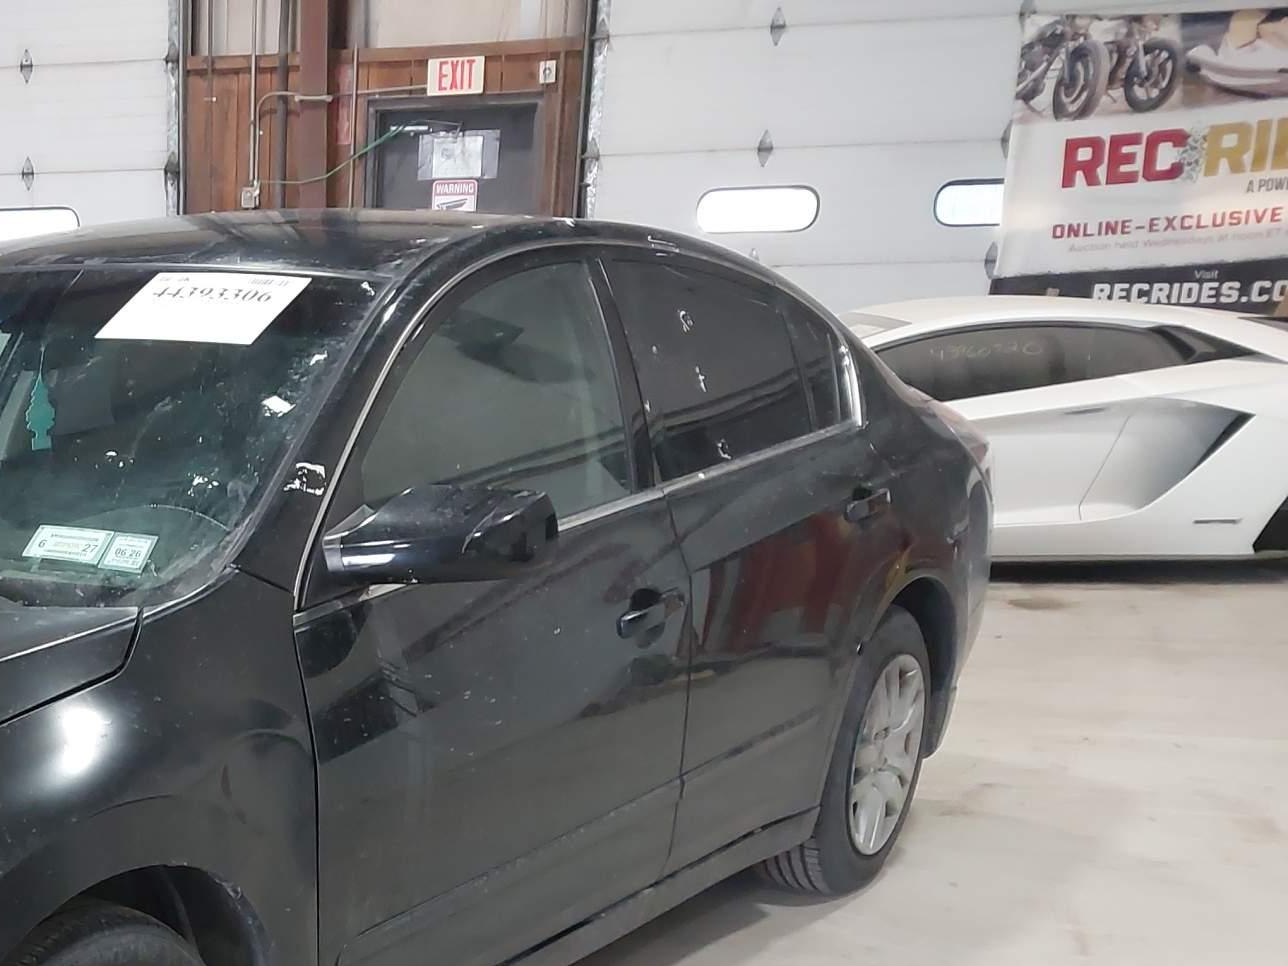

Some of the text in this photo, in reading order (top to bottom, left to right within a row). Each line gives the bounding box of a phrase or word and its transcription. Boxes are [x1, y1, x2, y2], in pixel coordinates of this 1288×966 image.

[437, 59, 476, 92] EXIT
[1061, 128, 1190, 188] REC
[435, 183, 474, 195] WARNING
[1246, 179, 1254, 193] A
[1051, 206, 1284, 240] ONLINE-EXCLUSIVE
[1194, 269, 1219, 280] Visit
[152, 286, 272, 303] 44393306
[38, 539, 48, 549] 6
[82, 543, 99, 554] 27
